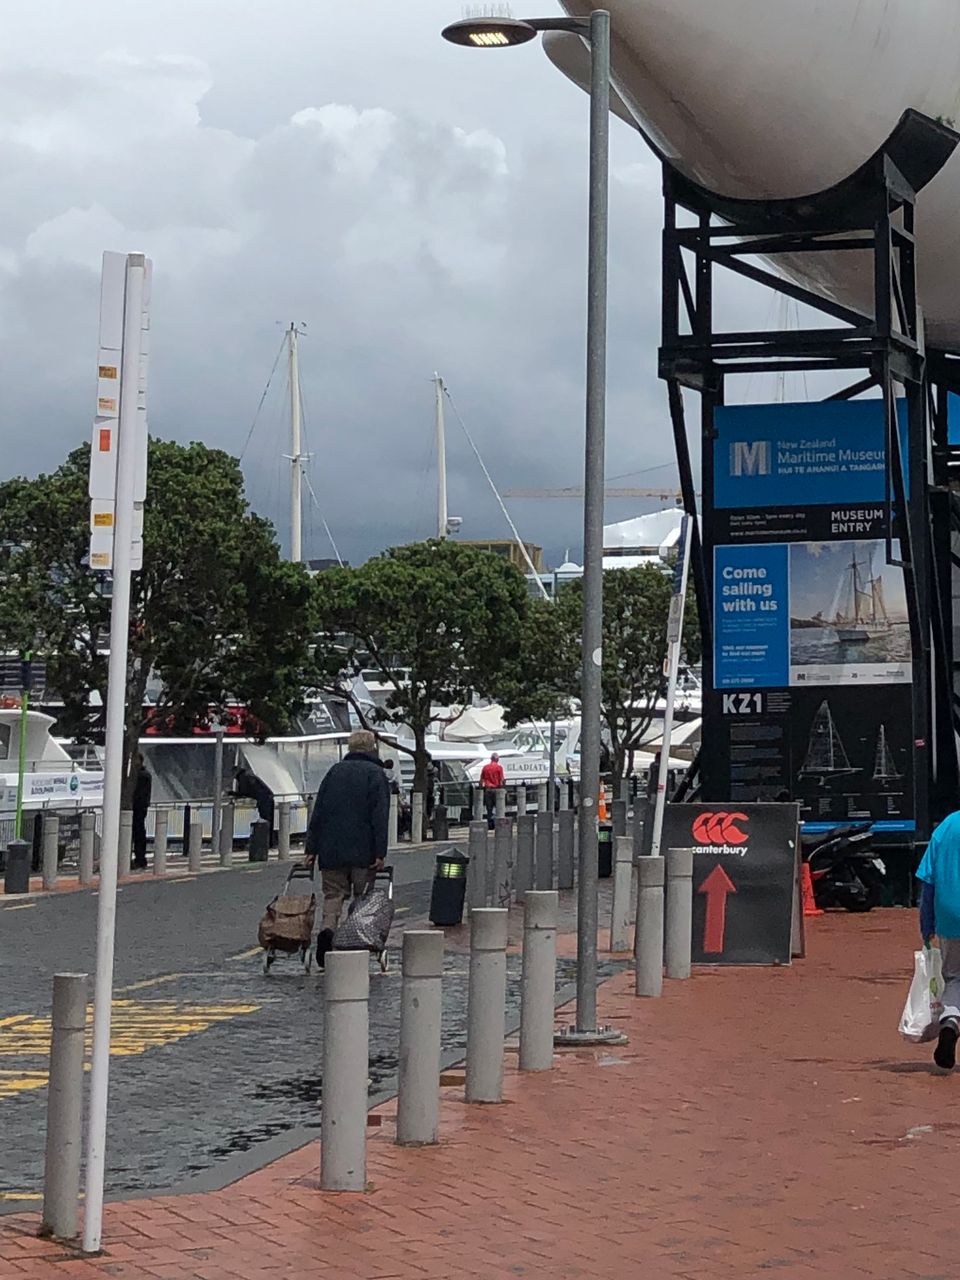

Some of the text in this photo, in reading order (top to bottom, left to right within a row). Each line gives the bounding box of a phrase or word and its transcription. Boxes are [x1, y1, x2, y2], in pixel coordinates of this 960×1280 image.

[777, 438, 836, 449] New Zealand
[730, 440, 771, 476] M
[778, 449, 886, 464] Maritime Museu
[831, 510, 883, 520] MUSEUM
[831, 522, 872, 533] ENTRY
[722, 566, 767, 579] Come
[722, 583, 773, 597] sailing
[722, 598, 778, 612] with us
[723, 693, 762, 714] KZ1
[691, 844, 748, 857] canterbury
